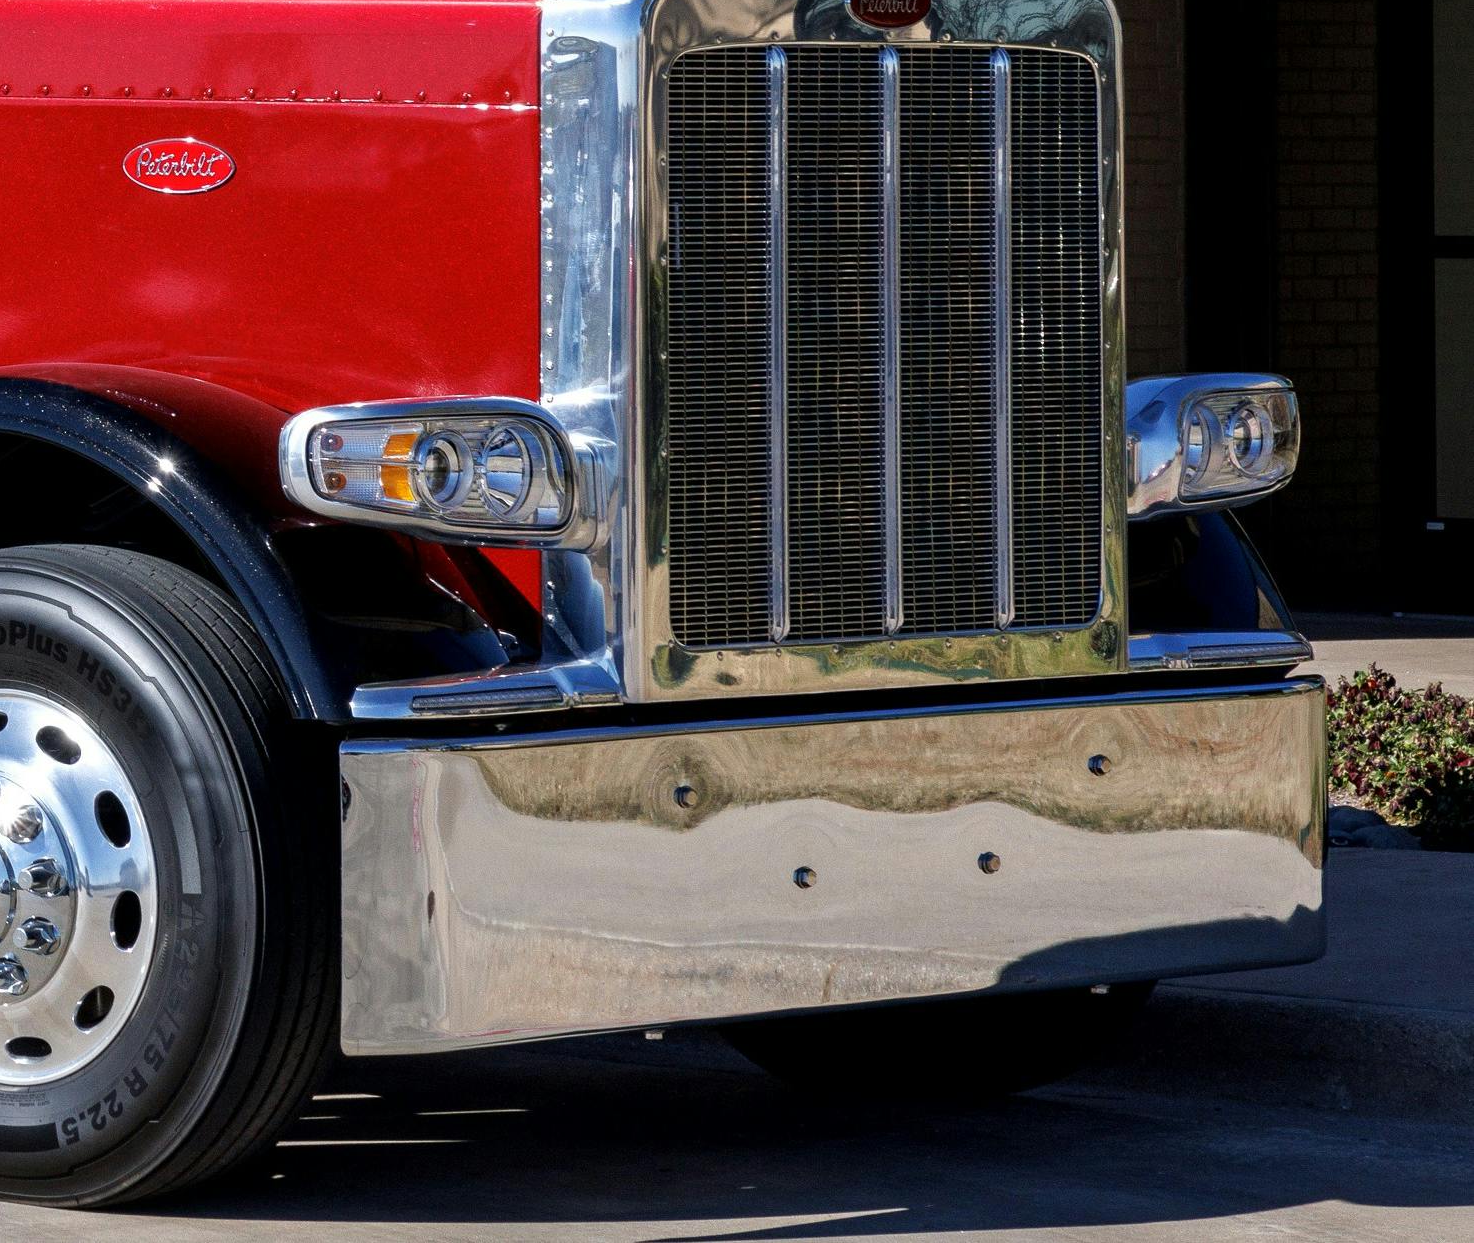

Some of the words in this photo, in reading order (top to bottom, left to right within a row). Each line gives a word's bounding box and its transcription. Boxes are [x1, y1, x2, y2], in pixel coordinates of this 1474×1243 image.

[136, 147, 225, 178] Peterbilt
[142, 939, 199, 1073] 29/75
[123, 1065, 149, 1099] R
[60, 1089, 124, 1146] 22.5
